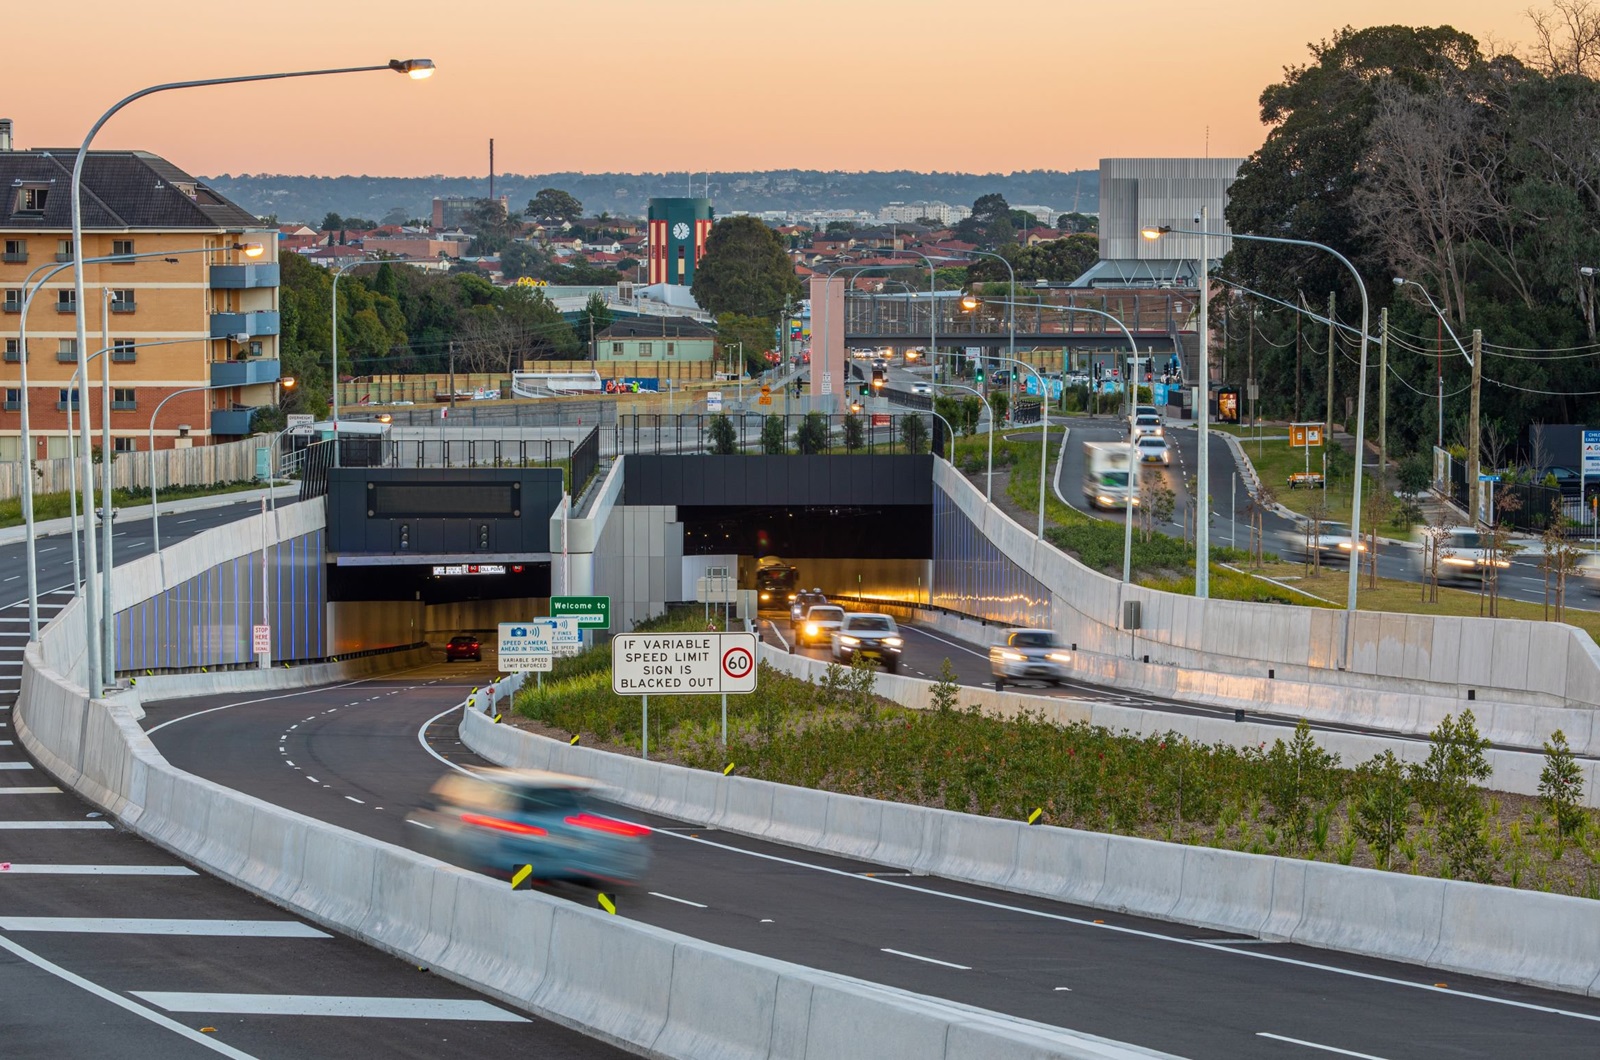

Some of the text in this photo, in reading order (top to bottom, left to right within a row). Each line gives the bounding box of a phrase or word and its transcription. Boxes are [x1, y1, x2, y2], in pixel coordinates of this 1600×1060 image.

[624, 640, 710, 649] IF VARIABLE
[626, 652, 709, 662] SPEED LIMIT
[728, 656, 748, 670] 60
[643, 665, 692, 675] SIGN IS
[621, 678, 714, 688] BLACKED OUT
